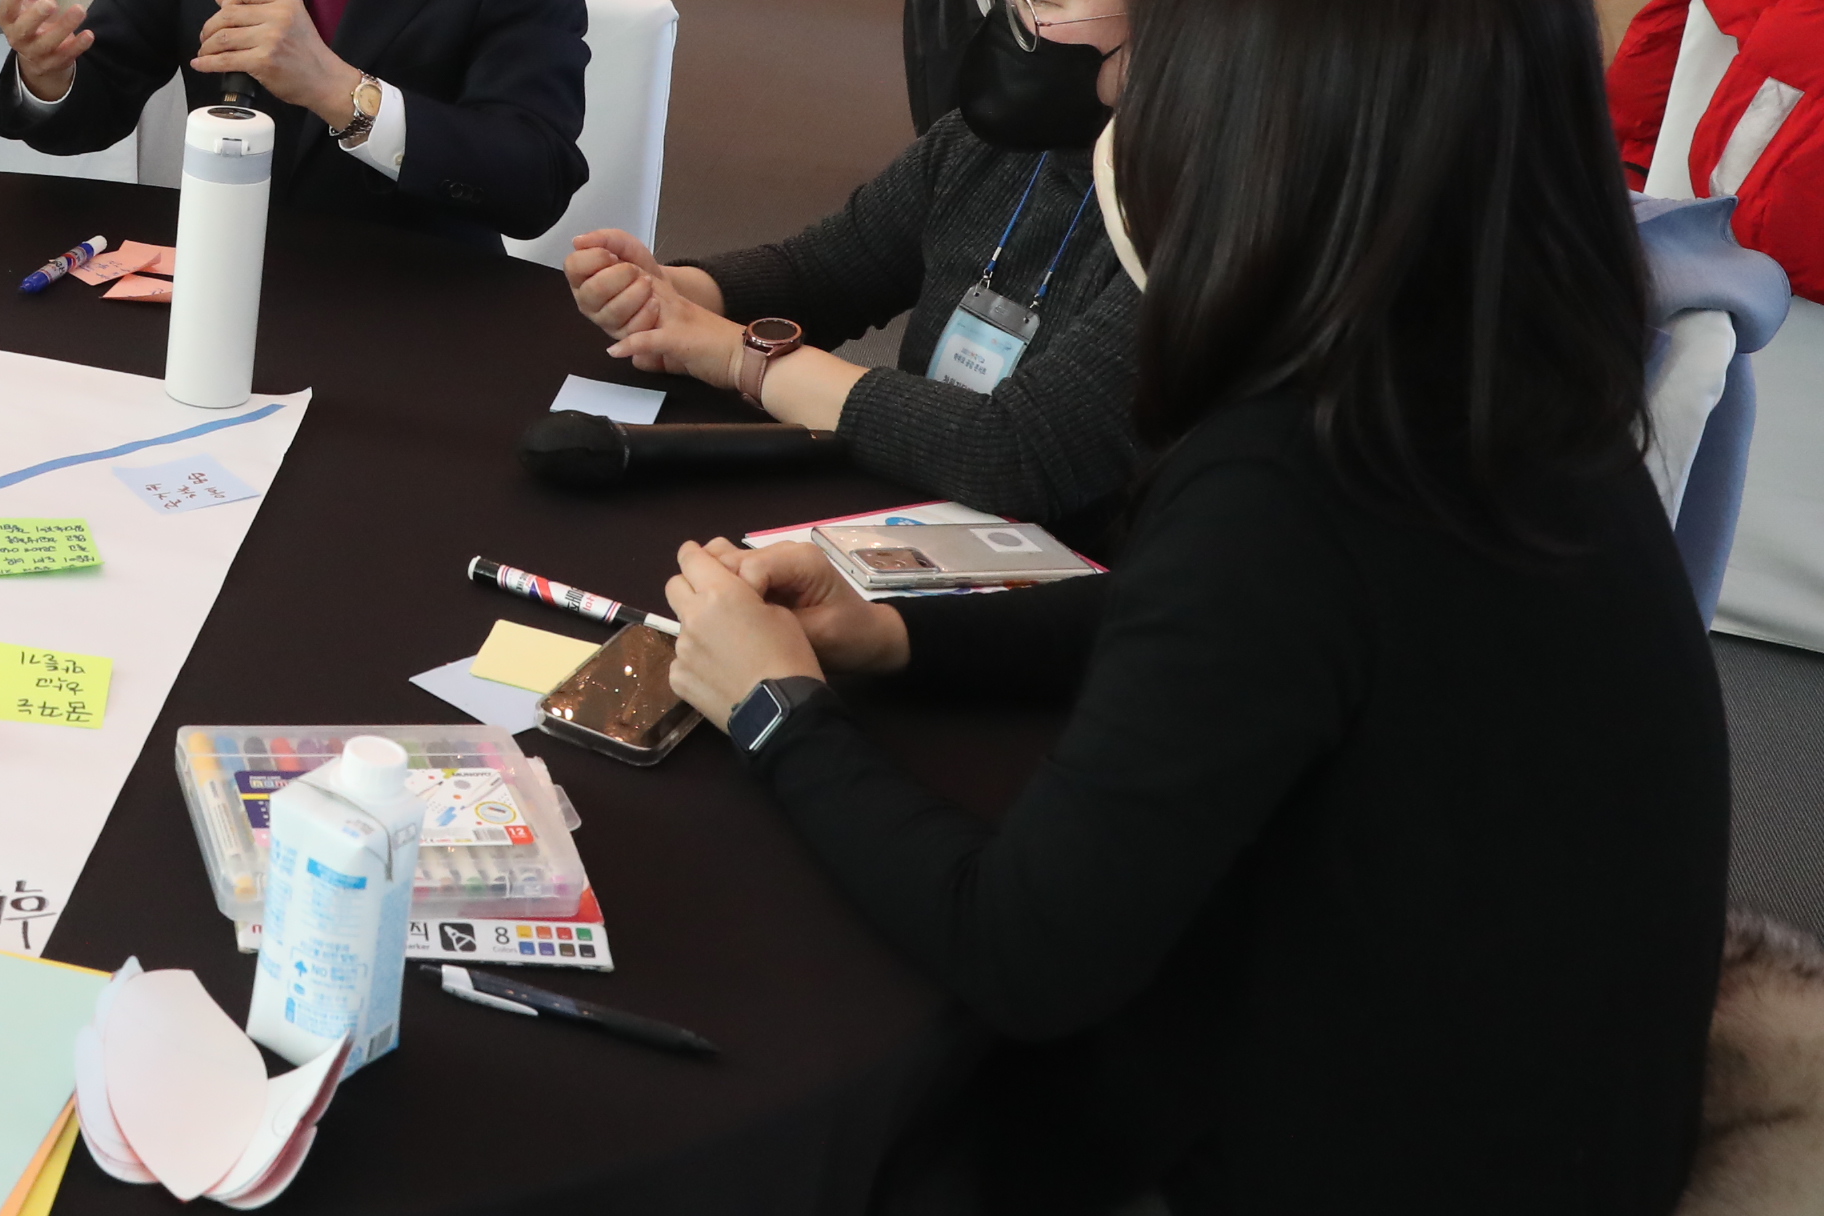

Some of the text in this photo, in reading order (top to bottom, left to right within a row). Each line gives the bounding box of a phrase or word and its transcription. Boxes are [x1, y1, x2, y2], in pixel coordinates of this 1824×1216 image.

[20, 651, 86, 675] 만들기
[35, 677, 84, 695] 학교
[17, 695, 92, 724] 꿈꾸는
[495, 926, 511, 945] 8
